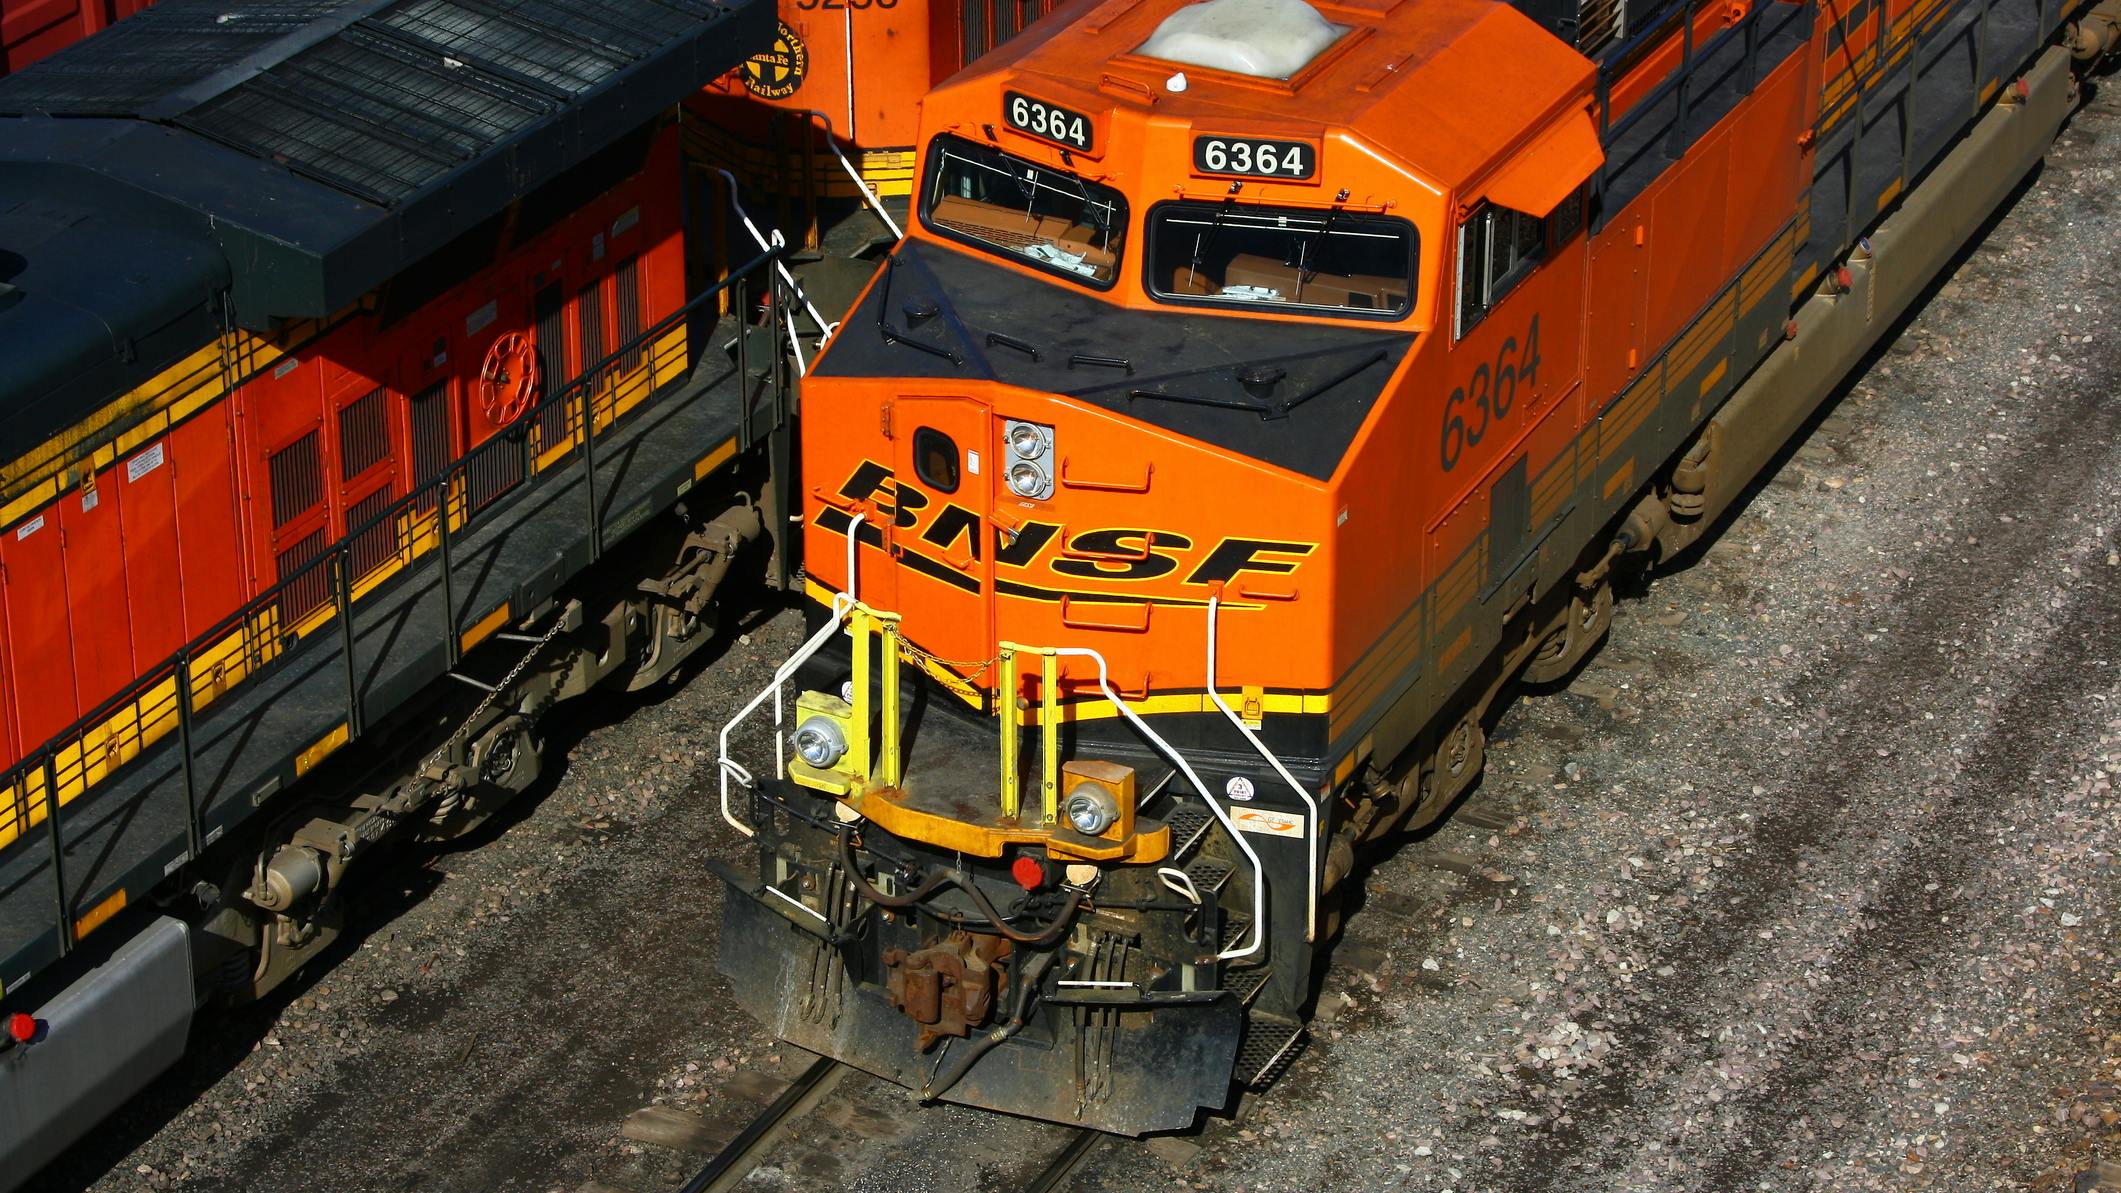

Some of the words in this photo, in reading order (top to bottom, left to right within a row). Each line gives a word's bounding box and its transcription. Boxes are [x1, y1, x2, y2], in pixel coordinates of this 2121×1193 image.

[777, 54, 788, 65] Fe
[745, 75, 793, 97] Railway
[1012, 97, 1086, 147] 6364
[1205, 139, 1303, 175] 6364
[1440, 312, 1541, 473] 6364
[835, 458, 1320, 587] BNSF
